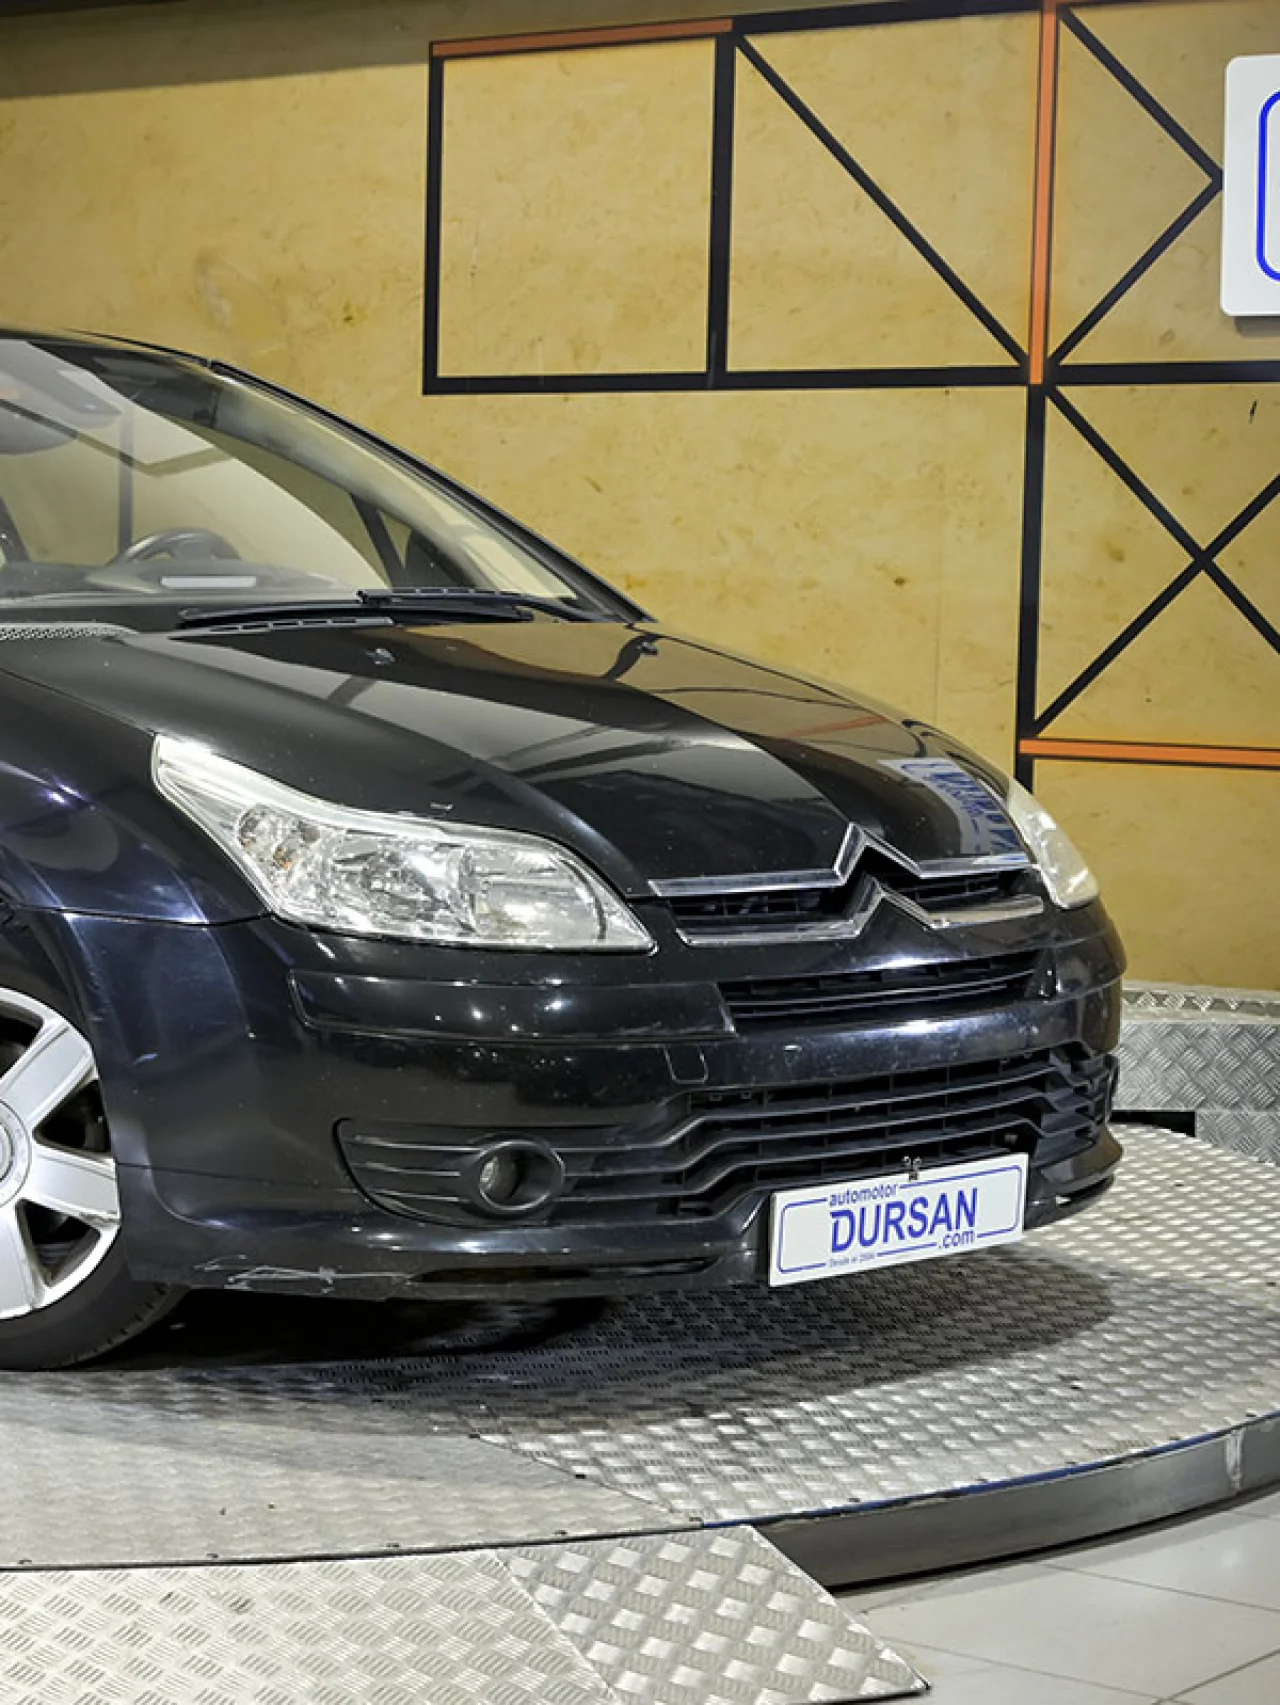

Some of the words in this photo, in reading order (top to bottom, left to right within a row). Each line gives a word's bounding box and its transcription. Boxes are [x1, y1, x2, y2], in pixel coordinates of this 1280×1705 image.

[829, 1184, 898, 1206] automotor
[830, 1187, 978, 1253] DURSAN
[938, 1230, 975, 1249] .com
